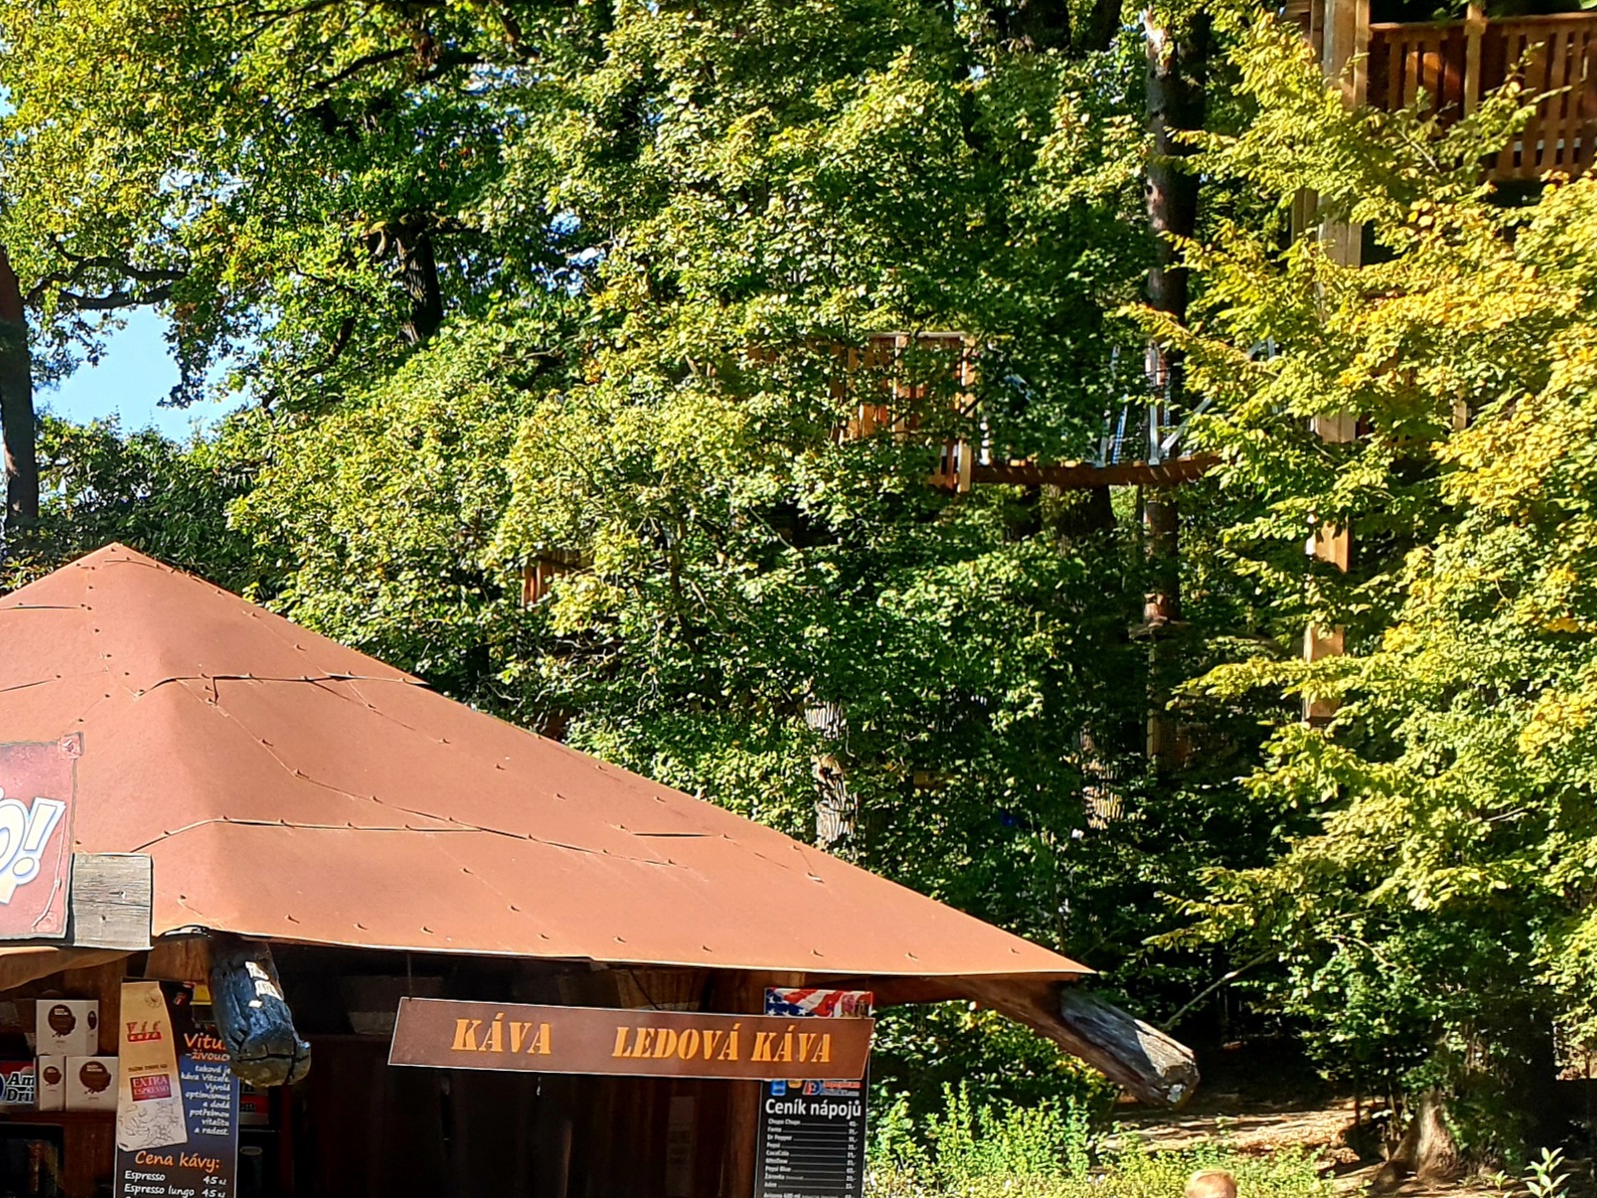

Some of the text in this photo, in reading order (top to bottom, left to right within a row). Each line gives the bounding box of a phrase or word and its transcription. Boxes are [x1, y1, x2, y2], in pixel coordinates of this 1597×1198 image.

[184, 1032, 226, 1050] Vitu
[451, 1013, 831, 1062] KÁVA LEDOVÁ KÁVA
[133, 1075, 168, 1088] EXTRA
[765, 1098, 862, 1120] Ceník nápojů
[135, 1150, 220, 1173] Cena kávy:
[124, 1170, 166, 1183] Espresso
[203, 1175, 219, 1185] 45
[124, 1183, 165, 1196] Espresso
[168, 1185, 195, 1198] lungo
[201, 1188, 217, 1198] 45
